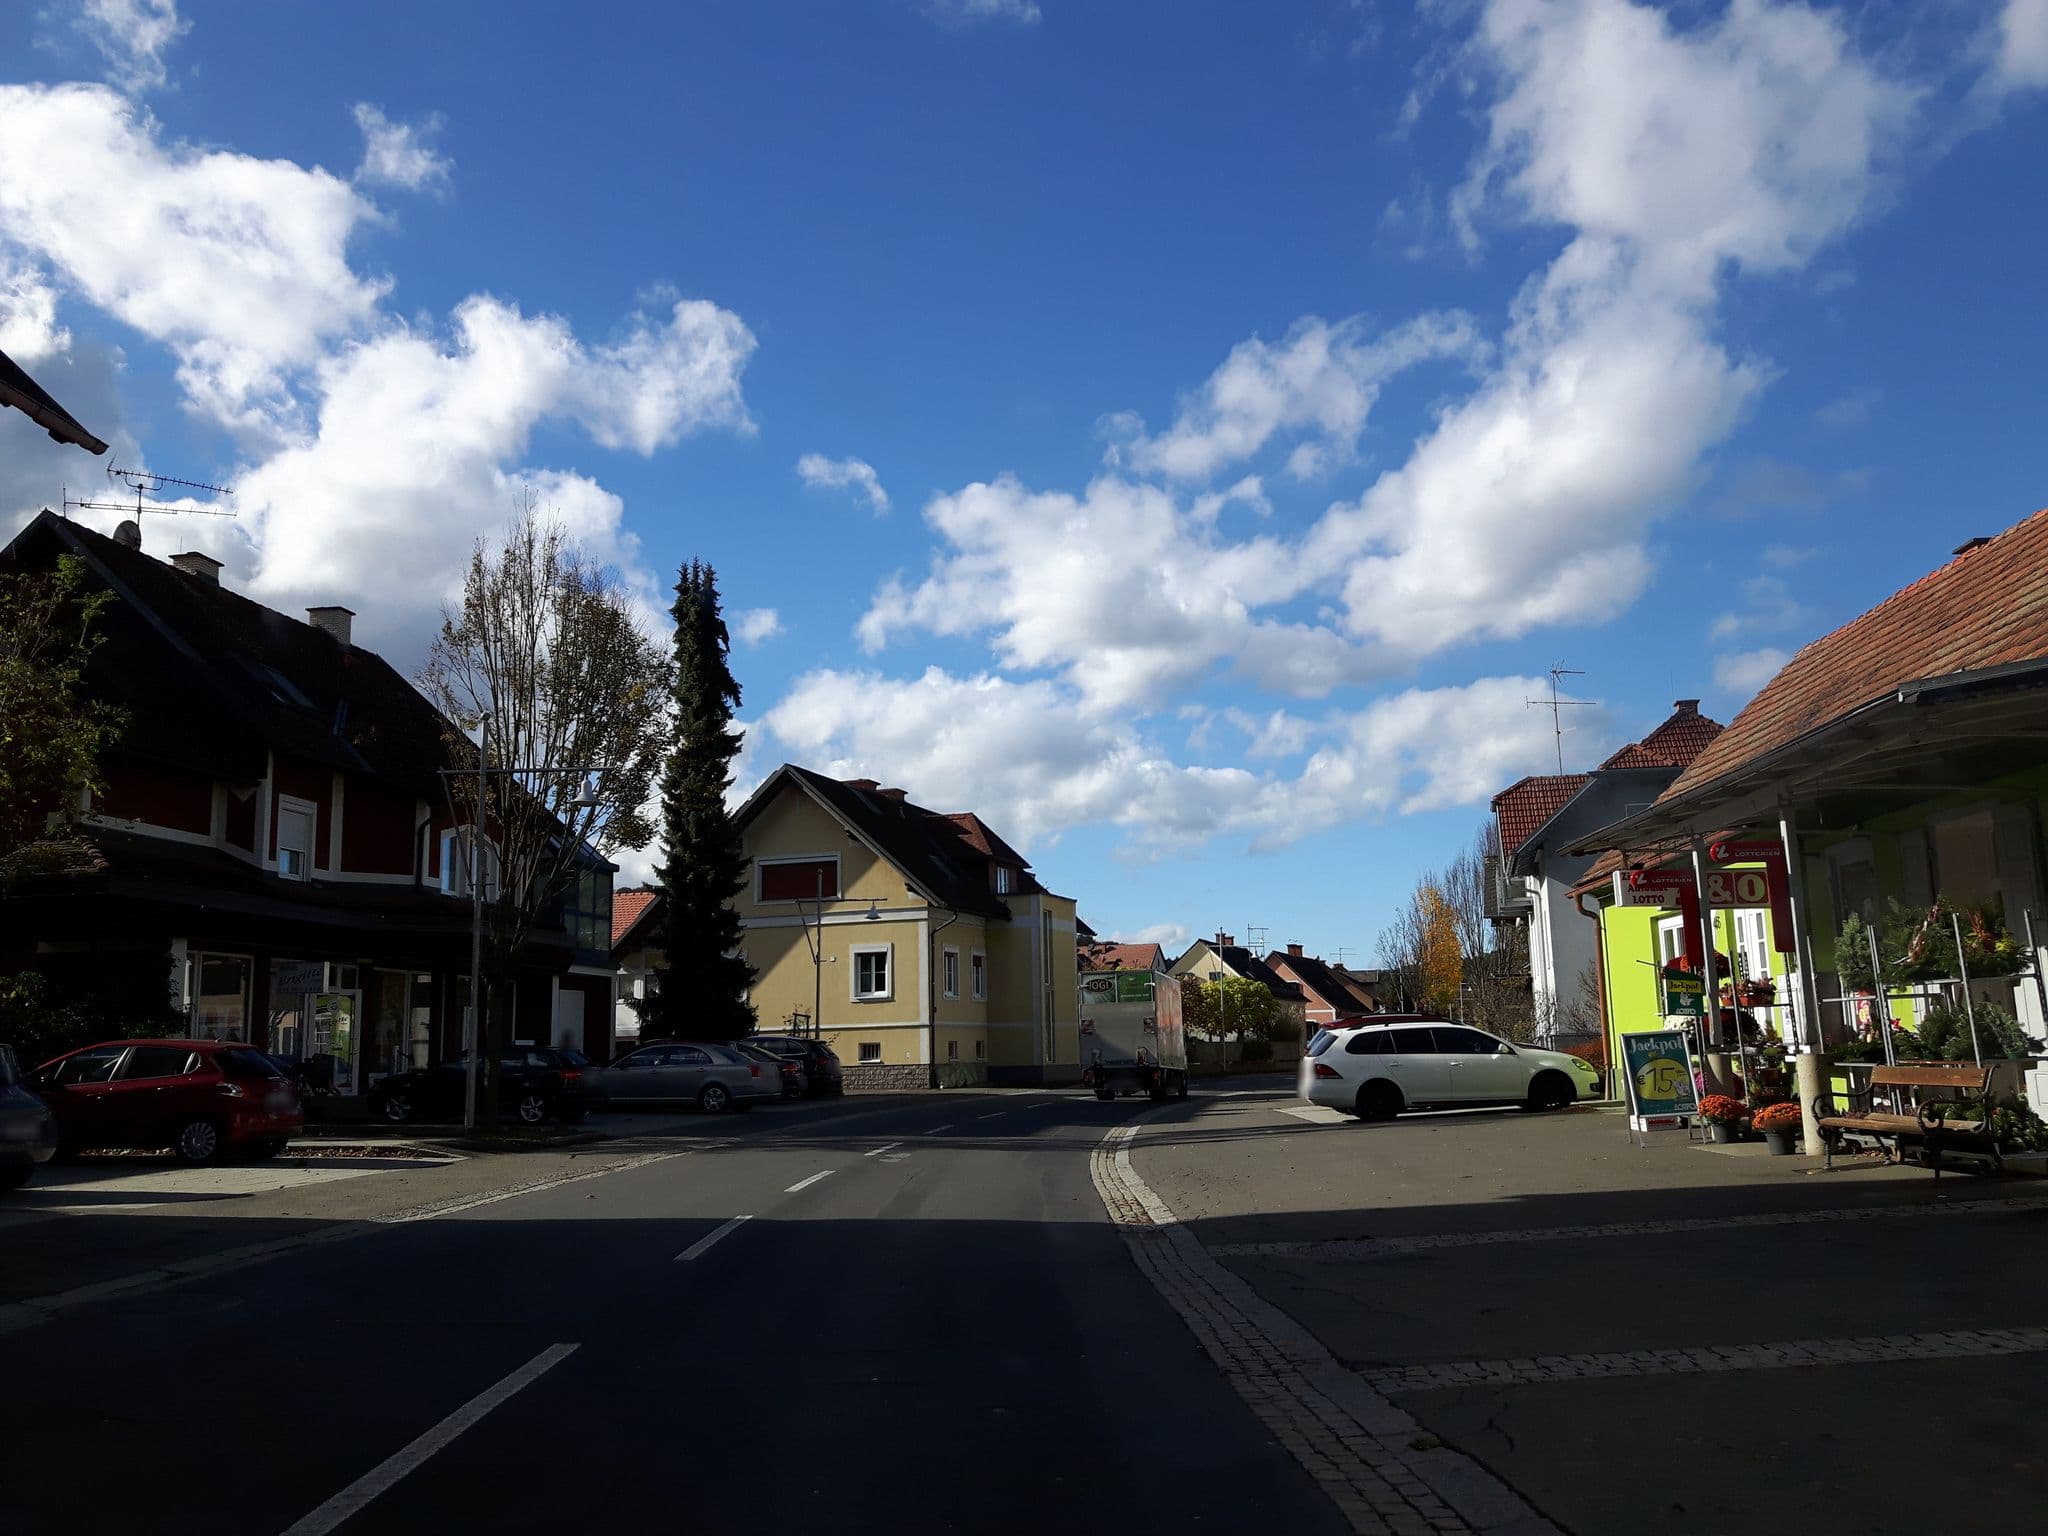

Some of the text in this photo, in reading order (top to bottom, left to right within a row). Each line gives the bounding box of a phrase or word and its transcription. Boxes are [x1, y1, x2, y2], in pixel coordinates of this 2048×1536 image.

[1632, 895, 1665, 904] LOTTO
[1670, 981, 1698, 992] Jackpot
[1629, 1036, 1683, 1056] Jackpot
